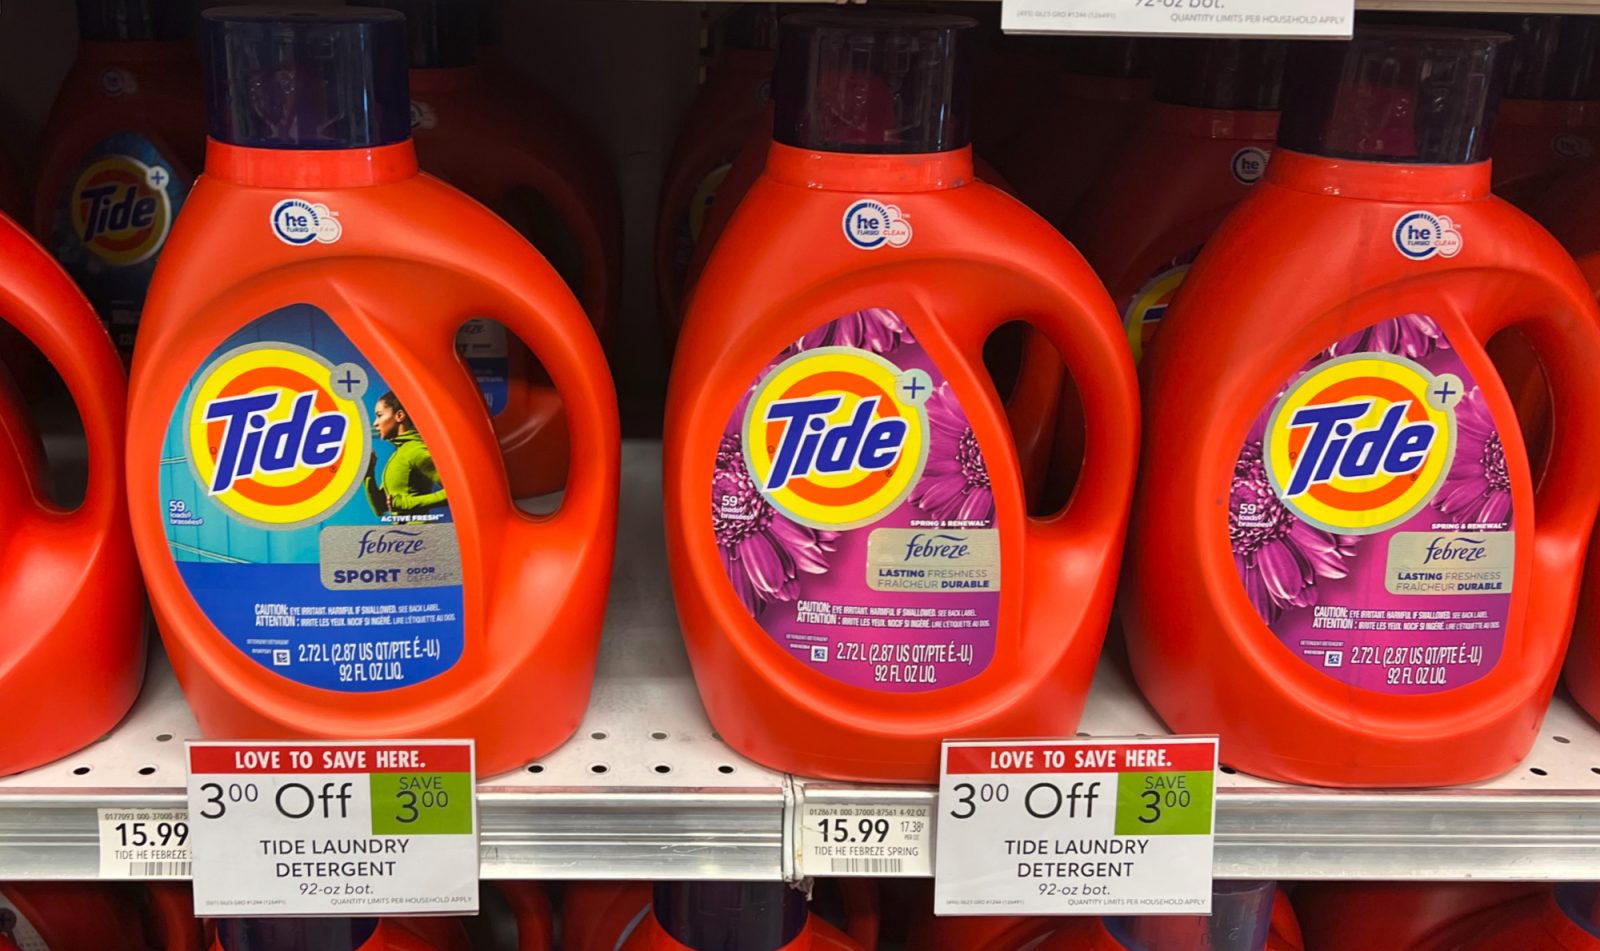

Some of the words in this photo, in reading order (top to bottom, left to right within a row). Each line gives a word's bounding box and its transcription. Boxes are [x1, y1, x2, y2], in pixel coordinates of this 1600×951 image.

[1170, 13, 1214, 22] QUANTITY
[1216, 14, 1243, 22] LIMITS
[1245, 14, 1261, 23] PER
[1262, 15, 1318, 23] HOUSEHOLD
[1319, 16, 1345, 24] APPLY
[80, 184, 157, 242] Tide
[285, 212, 307, 226] he
[857, 214, 878, 229] he
[1408, 225, 1430, 240] he
[202, 390, 349, 496] Tide
[763, 396, 909, 492] Tide
[1283, 400, 1437, 499] Tide
[170, 500, 185, 512] 59
[722, 495, 738, 506] 59
[1240, 504, 1256, 514] 59
[357, 530, 425, 559] febreze
[904, 534, 968, 561] febreze
[1423, 536, 1486, 564] febreze
[334, 569, 401, 583] SPORT
[879, 569, 925, 577] LASTING
[928, 569, 988, 577] FRESHNESS
[1398, 572, 1442, 580] LASTING
[1445, 572, 1501, 580] FRESHNESS
[878, 579, 938, 588] FRAÎCHEUR
[941, 580, 990, 588] DURABLE
[1396, 582, 1455, 591] FRAÎCHEUR
[1457, 582, 1502, 590] DURABLE
[255, 604, 288, 615] CAUTION:
[797, 600, 830, 613] CAUTION:
[1314, 606, 1348, 617] CAUTION:
[256, 616, 296, 626] ATTENTION
[797, 612, 837, 624] ATTENTION
[1312, 618, 1353, 629] ATTENTION
[299, 644, 321, 662] 2.72
[322, 644, 329, 662] L
[332, 643, 356, 665] (2.87
[359, 642, 373, 661] US
[376, 640, 411, 660] QT/PTE
[836, 642, 858, 660] 2.72
[861, 644, 867, 660] L
[869, 644, 894, 664] (2.87
[896, 645, 909, 662] US
[912, 644, 946, 662] QT/PTE
[1351, 647, 1372, 664] 2.72
[1374, 647, 1381, 664] L
[1383, 647, 1407, 668] (2.87
[1409, 647, 1423, 665] US
[1425, 646, 1457, 664] QT/PTE
[339, 664, 352, 681] 92
[355, 664, 367, 681] FL
[369, 663, 383, 681] OZ
[385, 662, 404, 680] LIQ.
[875, 665, 888, 682] 92
[890, 666, 901, 682] FL
[904, 665, 917, 682] OZ
[919, 664, 937, 683] LIQ.
[1387, 667, 1400, 684] 92
[1402, 668, 1412, 684] FL
[1416, 668, 1429, 684] OZ
[1431, 667, 1446, 684] LIQ.
[235, 751, 280, 769] LOVE
[289, 751, 313, 768] TO
[323, 751, 366, 768] SAVE
[376, 750, 426, 768] HERE.
[990, 751, 1034, 769] LOVE
[1043, 750, 1065, 768] TO
[1075, 750, 1116, 768] SAVE
[1125, 749, 1172, 767] HERE.
[400, 776, 442, 790] SAVE
[1145, 776, 1186, 789] SAVE
[276, 783, 352, 819] Off
[1025, 782, 1101, 818] Off
[115, 822, 189, 846] 15.99
[818, 819, 889, 842] 15.99
[260, 840, 306, 855] TIDE
[312, 838, 409, 854] LAUNDRY
[815, 847, 832, 855] TIDE
[836, 847, 846, 855] HE
[850, 847, 884, 855] FEBREZE
[888, 847, 919, 856] SPRING
[1004, 840, 1048, 855] TIDE
[1055, 840, 1149, 854] LAUNDRY
[115, 850, 133, 859] TIDE
[136, 850, 148, 859] HE
[151, 850, 186, 859] FEBREZE
[276, 862, 396, 877] DETERGENT
[1018, 862, 1134, 877] DETERGENT
[299, 883, 340, 895] 92-oz
[345, 883, 374, 895] bot.
[1038, 883, 1078, 895] 92-oz
[1082, 884, 1111, 895] bot.
